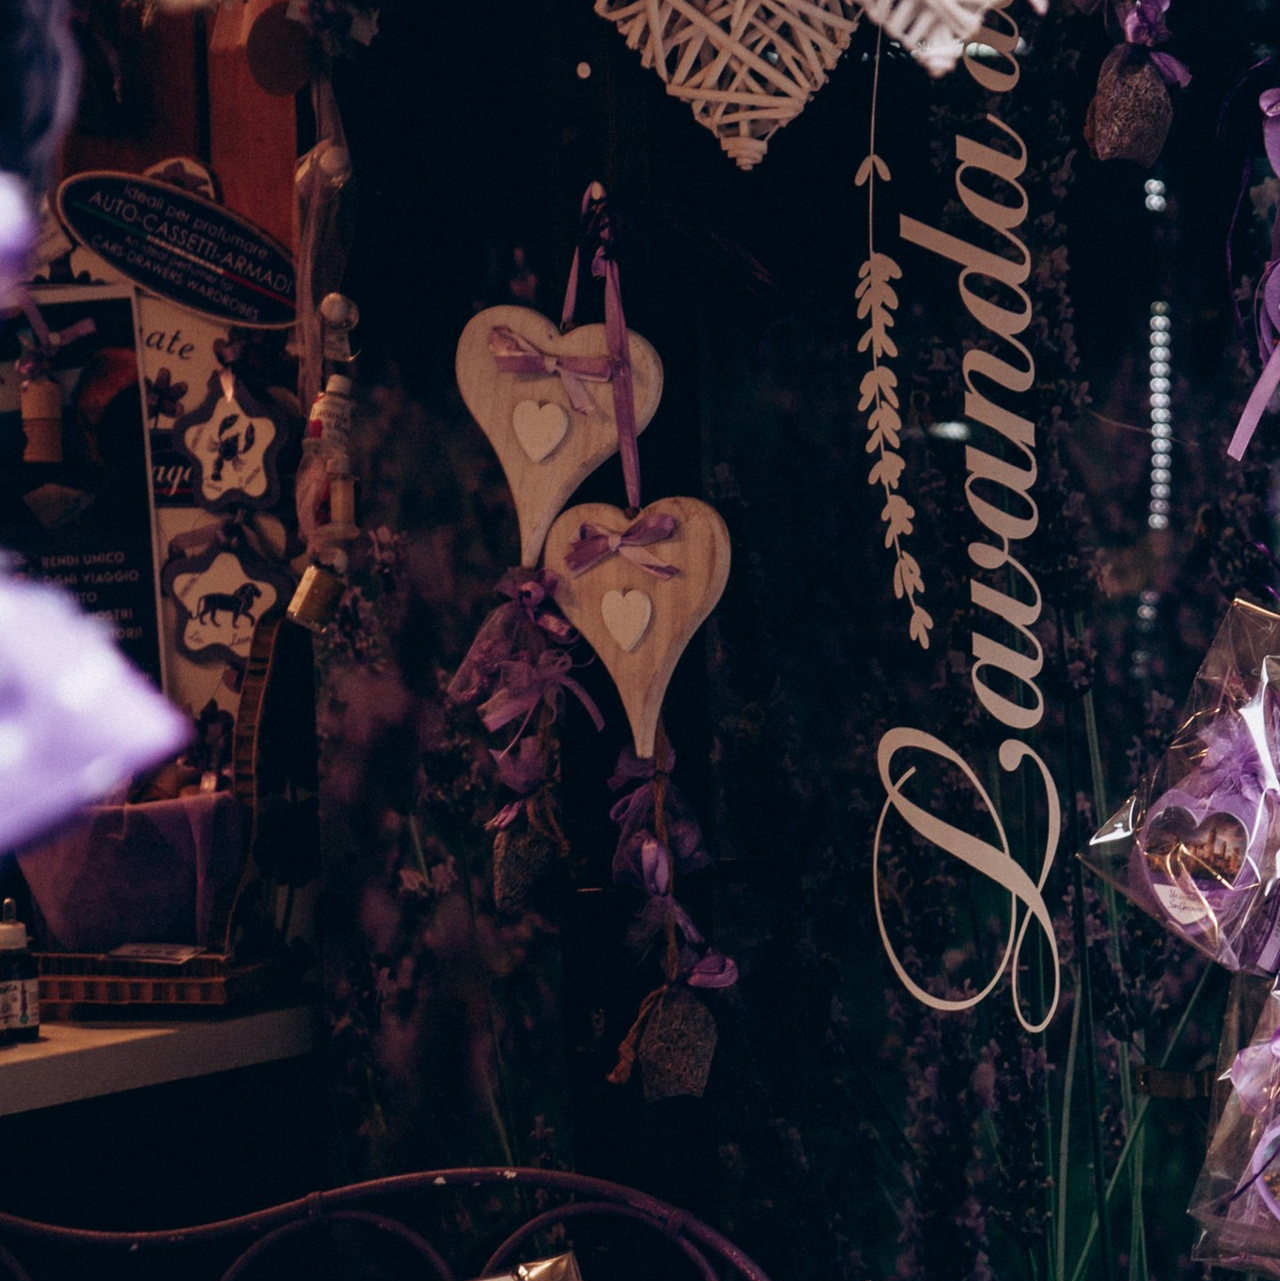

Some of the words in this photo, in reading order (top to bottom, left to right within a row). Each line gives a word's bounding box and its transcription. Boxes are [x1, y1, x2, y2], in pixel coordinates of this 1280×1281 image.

[83, 551, 126, 566] UNICO
[82, 569, 140, 584] VIAGGIO
[873, 113, 1060, 1034] Lavanda
